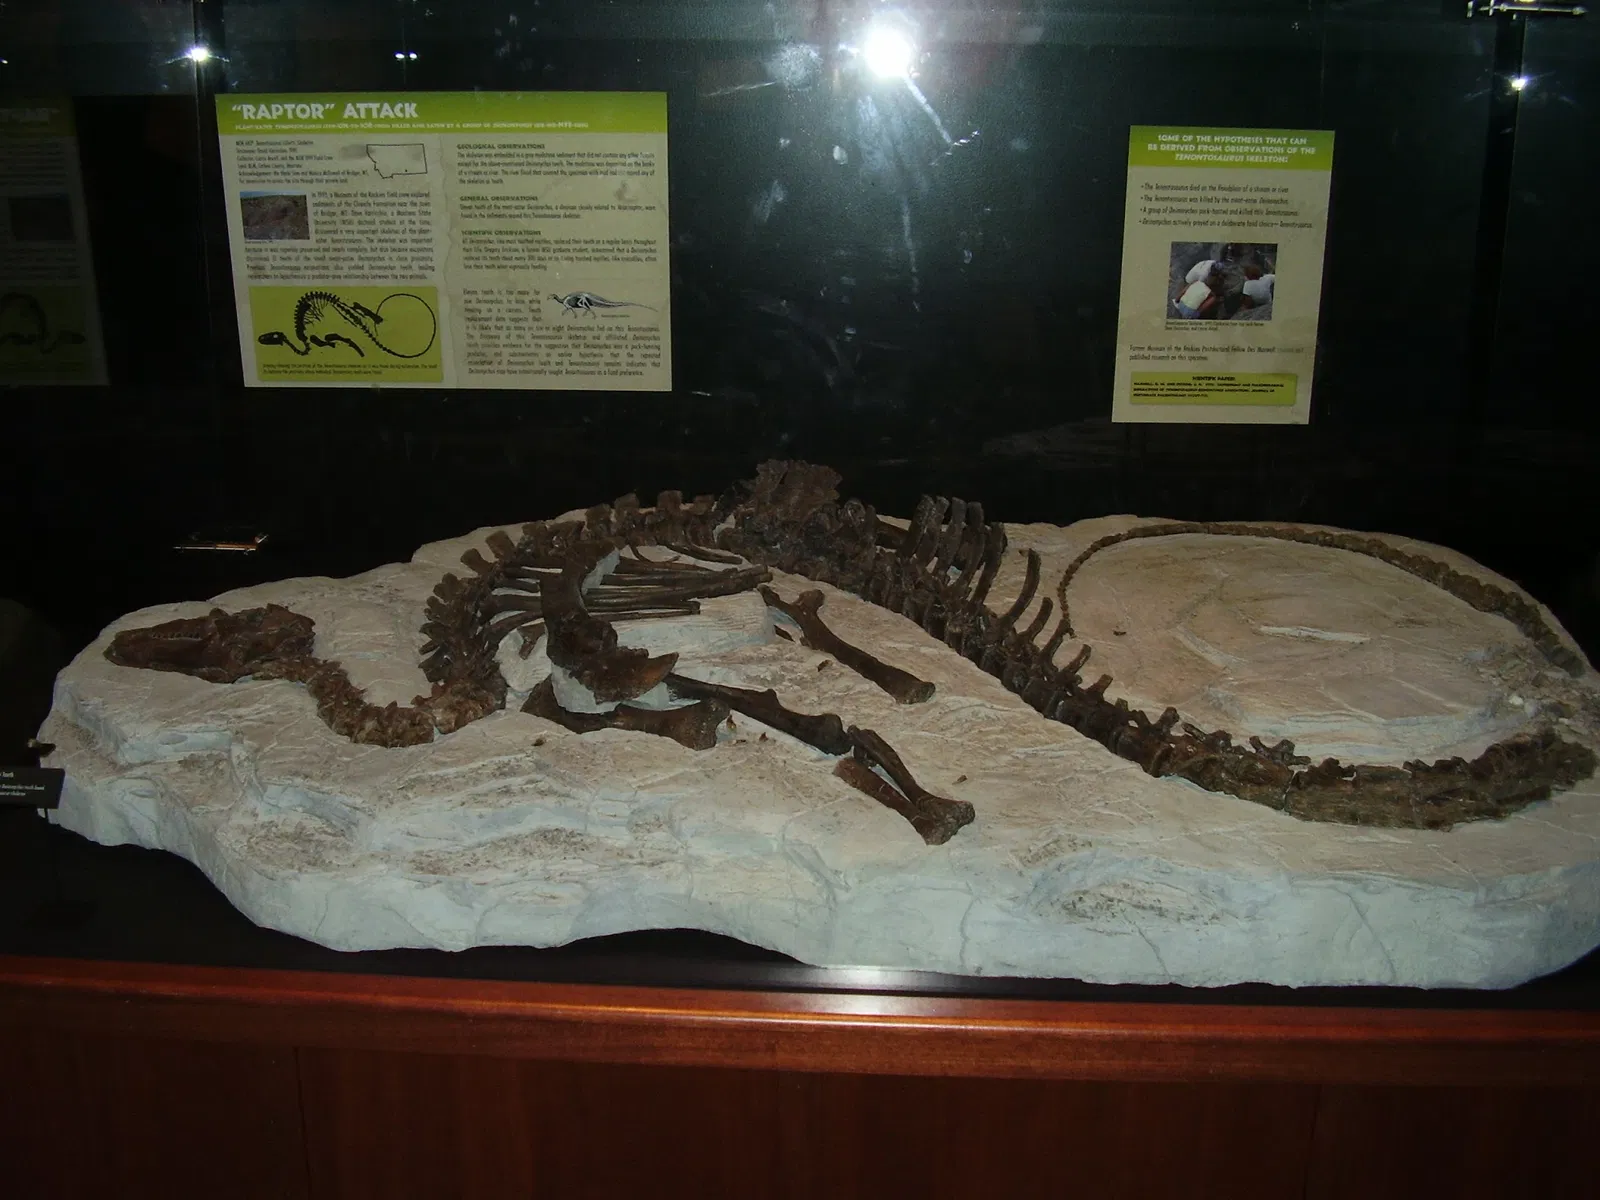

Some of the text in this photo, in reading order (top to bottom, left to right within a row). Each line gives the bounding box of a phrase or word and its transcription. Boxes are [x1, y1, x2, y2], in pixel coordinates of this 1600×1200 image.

[232, 102, 419, 120] “RAPTOR” ATTACK
[1158, 134, 1180, 142] SOME
[1195, 135, 1211, 143] THE
[1214, 136, 1264, 145] HYPOTHESES
[1266, 137, 1287, 145] THAT
[1147, 143, 1158, 151] BE
[1160, 144, 1195, 152] DERIVED
[1224, 145, 1284, 154] OBSERVATIONS
[1301, 147, 1317, 155] THE
[1175, 153, 1289, 163] TENONTOSAURUS SKELETON:
